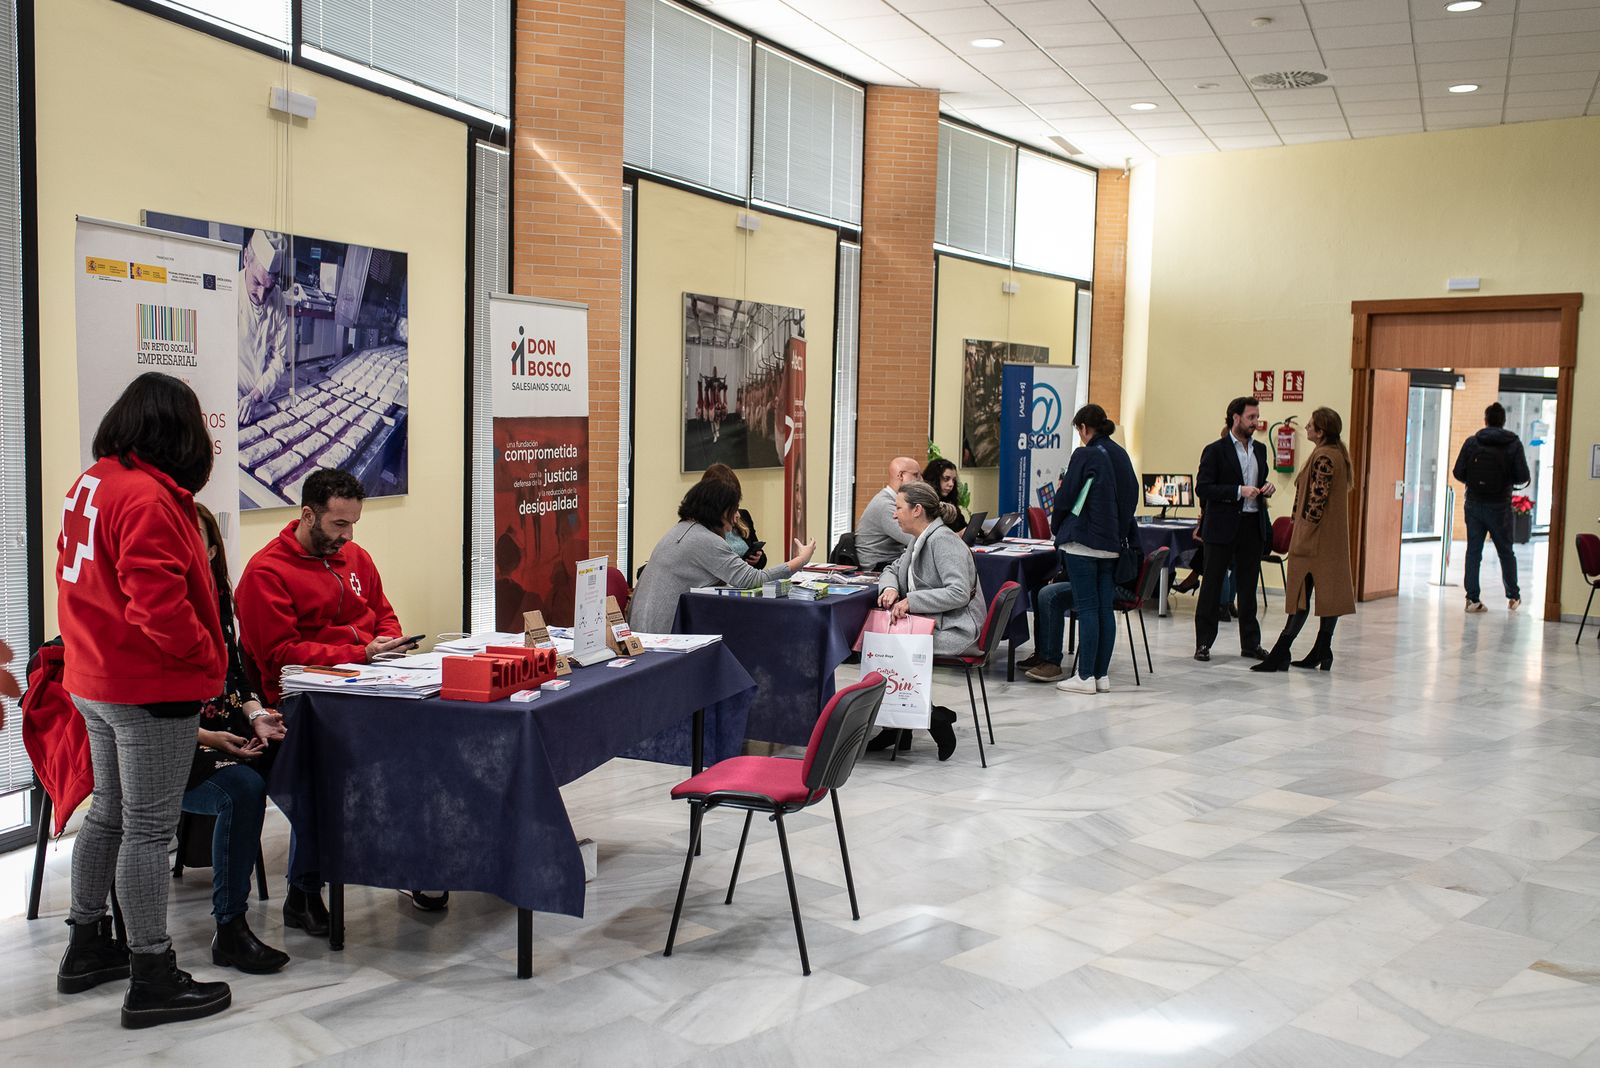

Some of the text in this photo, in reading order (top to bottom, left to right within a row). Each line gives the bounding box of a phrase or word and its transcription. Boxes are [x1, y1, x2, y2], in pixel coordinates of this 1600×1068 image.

[141, 342, 193, 354] UN RETO SOCIAL
[527, 338, 556, 355] DON
[137, 352, 198, 367] EMPRESARIAL
[528, 360, 571, 378] BOSCO
[511, 382, 571, 392] SALESIANOS SOCIAL
[515, 440, 538, 448] fundación
[1018, 427, 1061, 450] asein
[504, 443, 578, 463] comprometida
[543, 467, 578, 487] justicia
[545, 488, 566, 496] reducción
[518, 494, 578, 516] desigualdad
[886, 674, 913, 695] Sin
